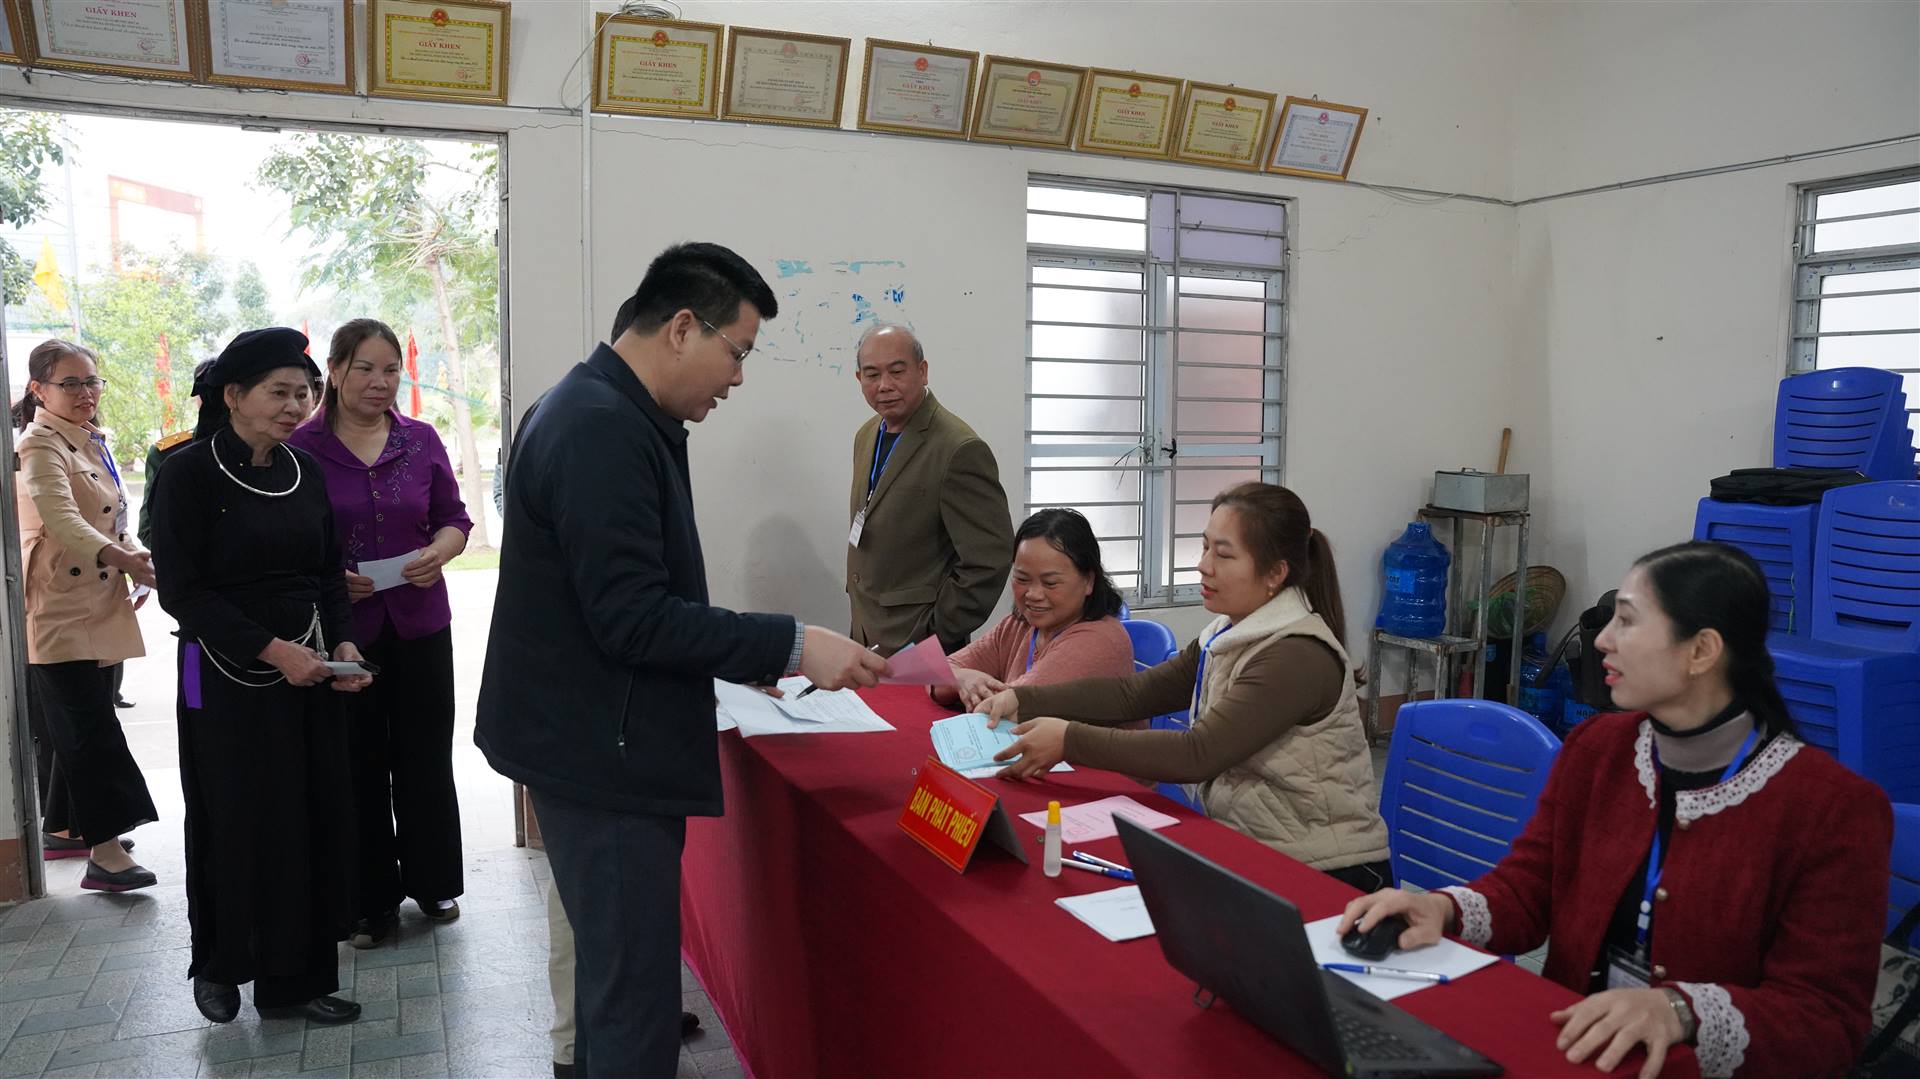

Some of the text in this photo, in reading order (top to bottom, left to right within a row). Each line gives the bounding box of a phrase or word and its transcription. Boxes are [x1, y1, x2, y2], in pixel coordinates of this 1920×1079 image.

[111, 9, 137, 18] KHEN
[439, 42, 461, 50] KHEN
[657, 61, 677, 69] KHEN
[924, 797, 954, 832] PHÁT
[944, 811, 978, 849] PHIẾU
